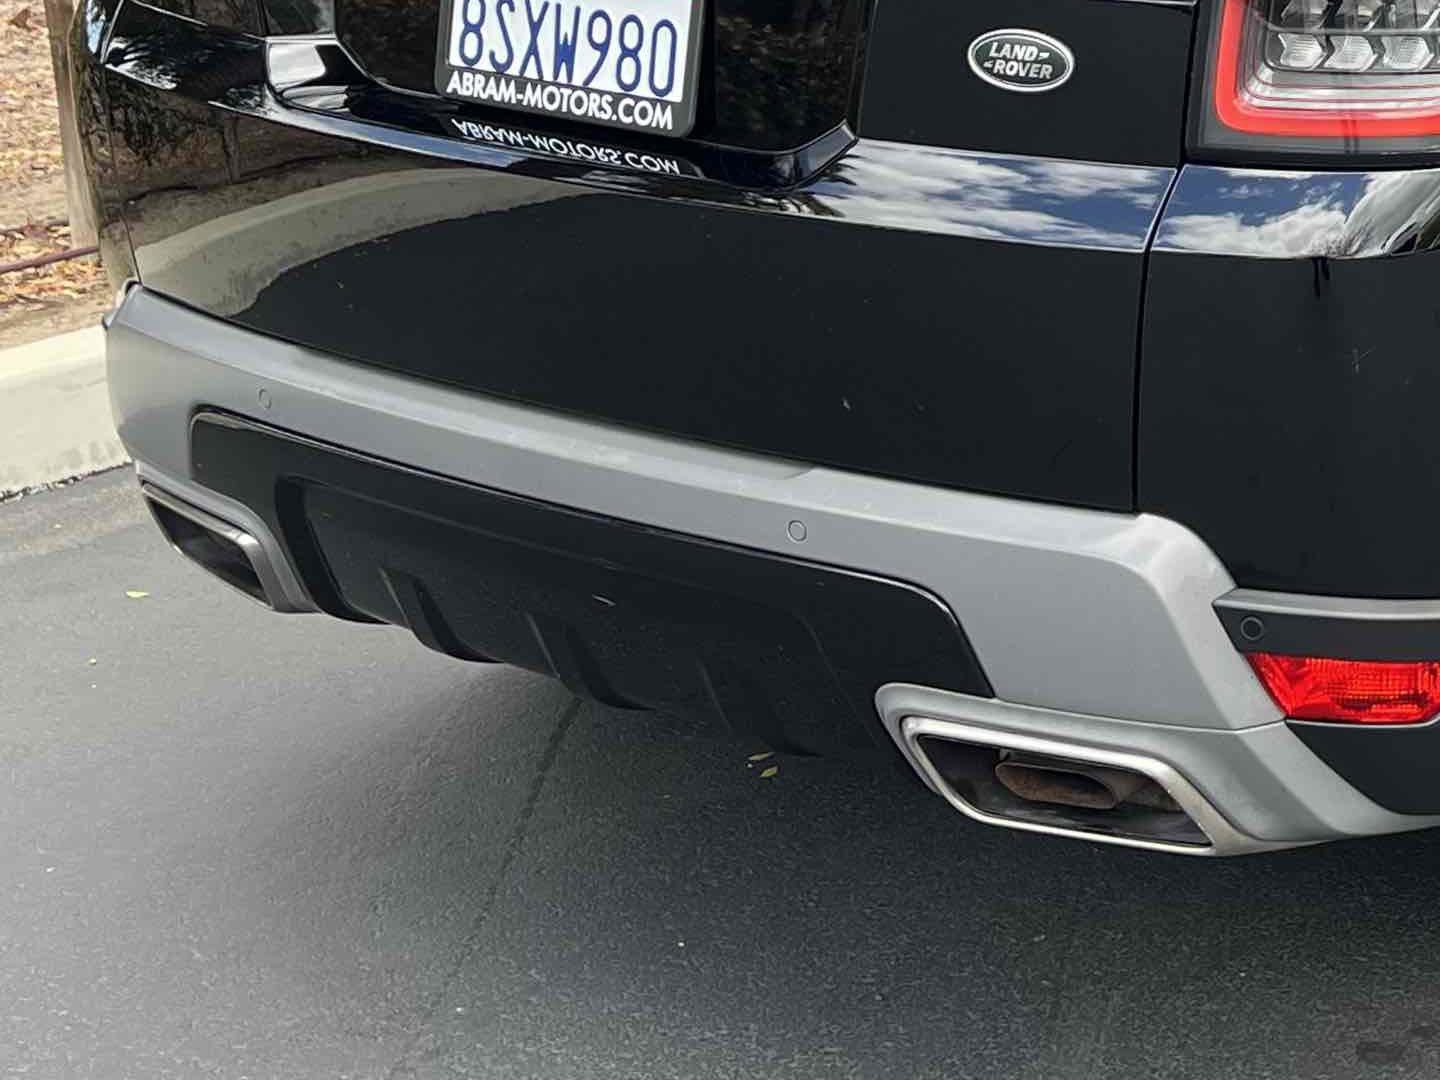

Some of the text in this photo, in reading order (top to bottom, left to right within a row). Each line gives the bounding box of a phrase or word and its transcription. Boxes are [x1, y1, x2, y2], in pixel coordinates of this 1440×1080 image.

[989, 41, 1039, 61] LAND
[992, 59, 1053, 79] ROVER
[446, 70, 673, 130] ABRAM-MOTORS.COM
